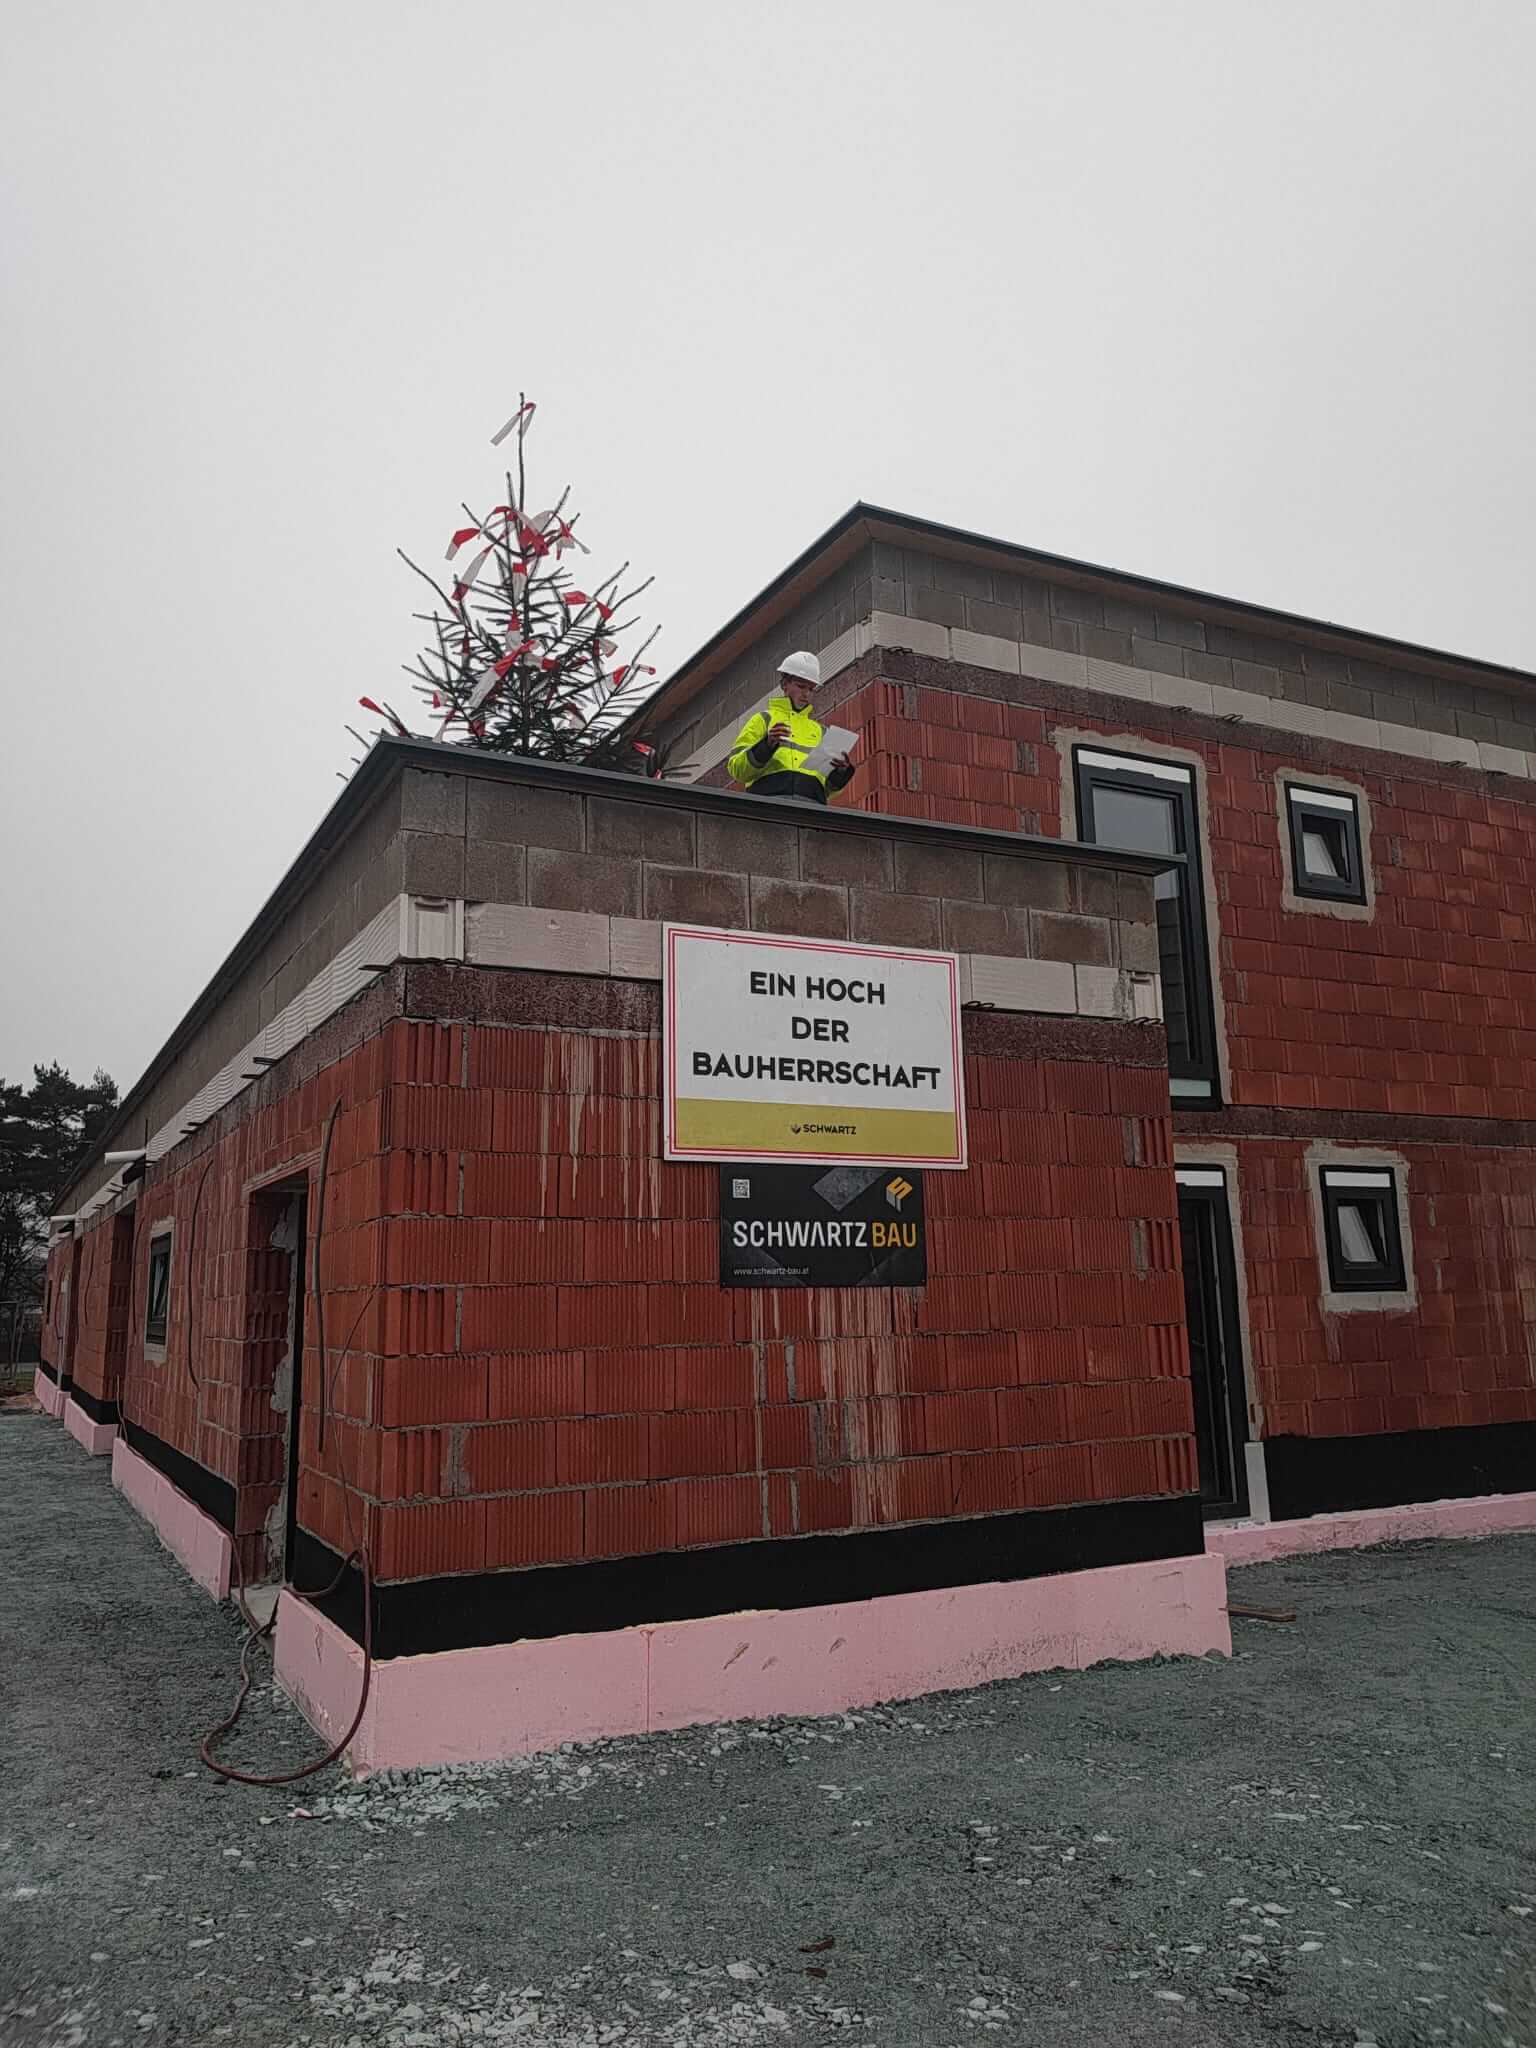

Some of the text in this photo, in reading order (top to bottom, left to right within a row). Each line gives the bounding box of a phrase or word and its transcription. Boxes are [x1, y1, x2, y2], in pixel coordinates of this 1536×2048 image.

[750, 971, 885, 1004] EIN HOCH
[791, 1017, 849, 1042] DER
[692, 1052, 941, 1089] BAUHERRSCHAFT
[803, 1125, 856, 1135] SCHWARTZ
[733, 1221, 916, 1247] SCHWARTZ BAU
